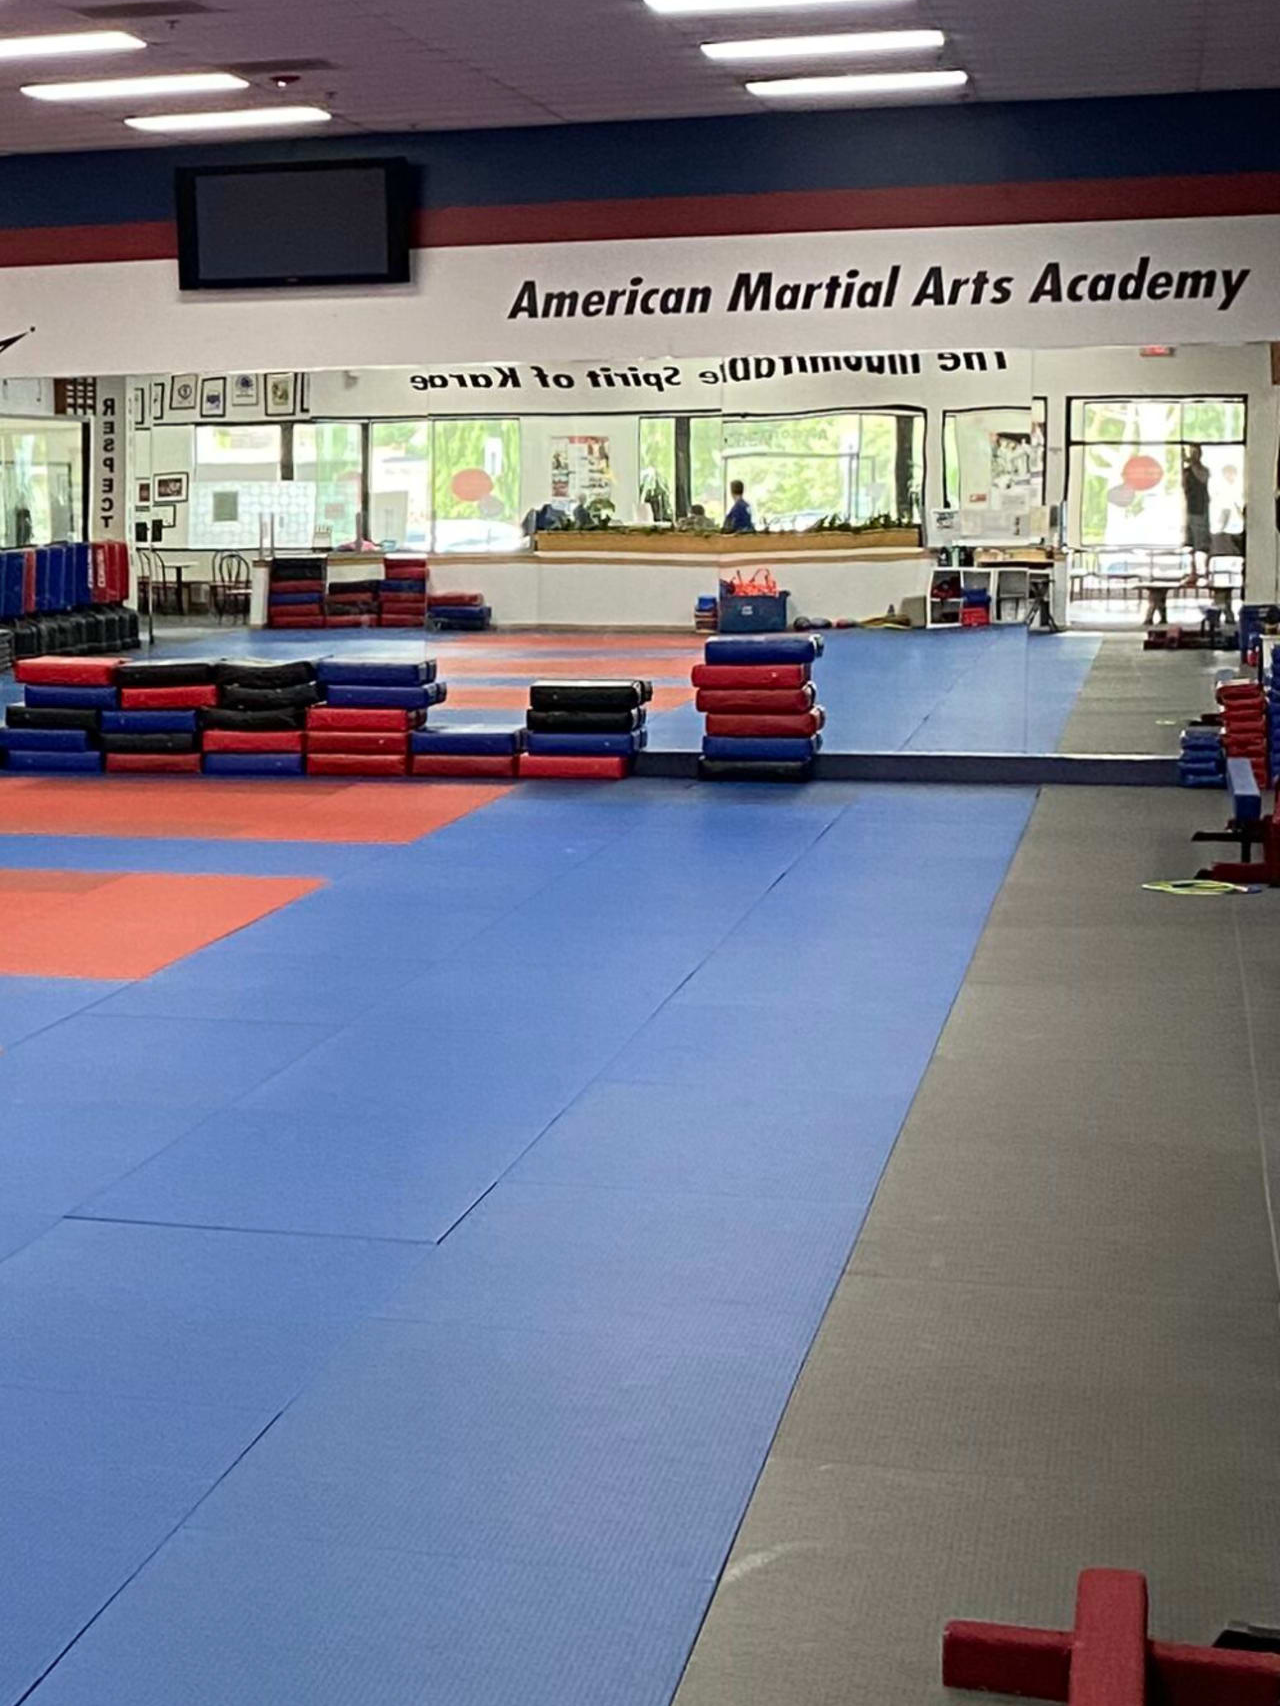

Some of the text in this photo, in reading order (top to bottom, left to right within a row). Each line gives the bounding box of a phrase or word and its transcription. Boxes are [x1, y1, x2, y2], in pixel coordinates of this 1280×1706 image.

[508, 256, 1251, 319] American Martial Arts Academy
